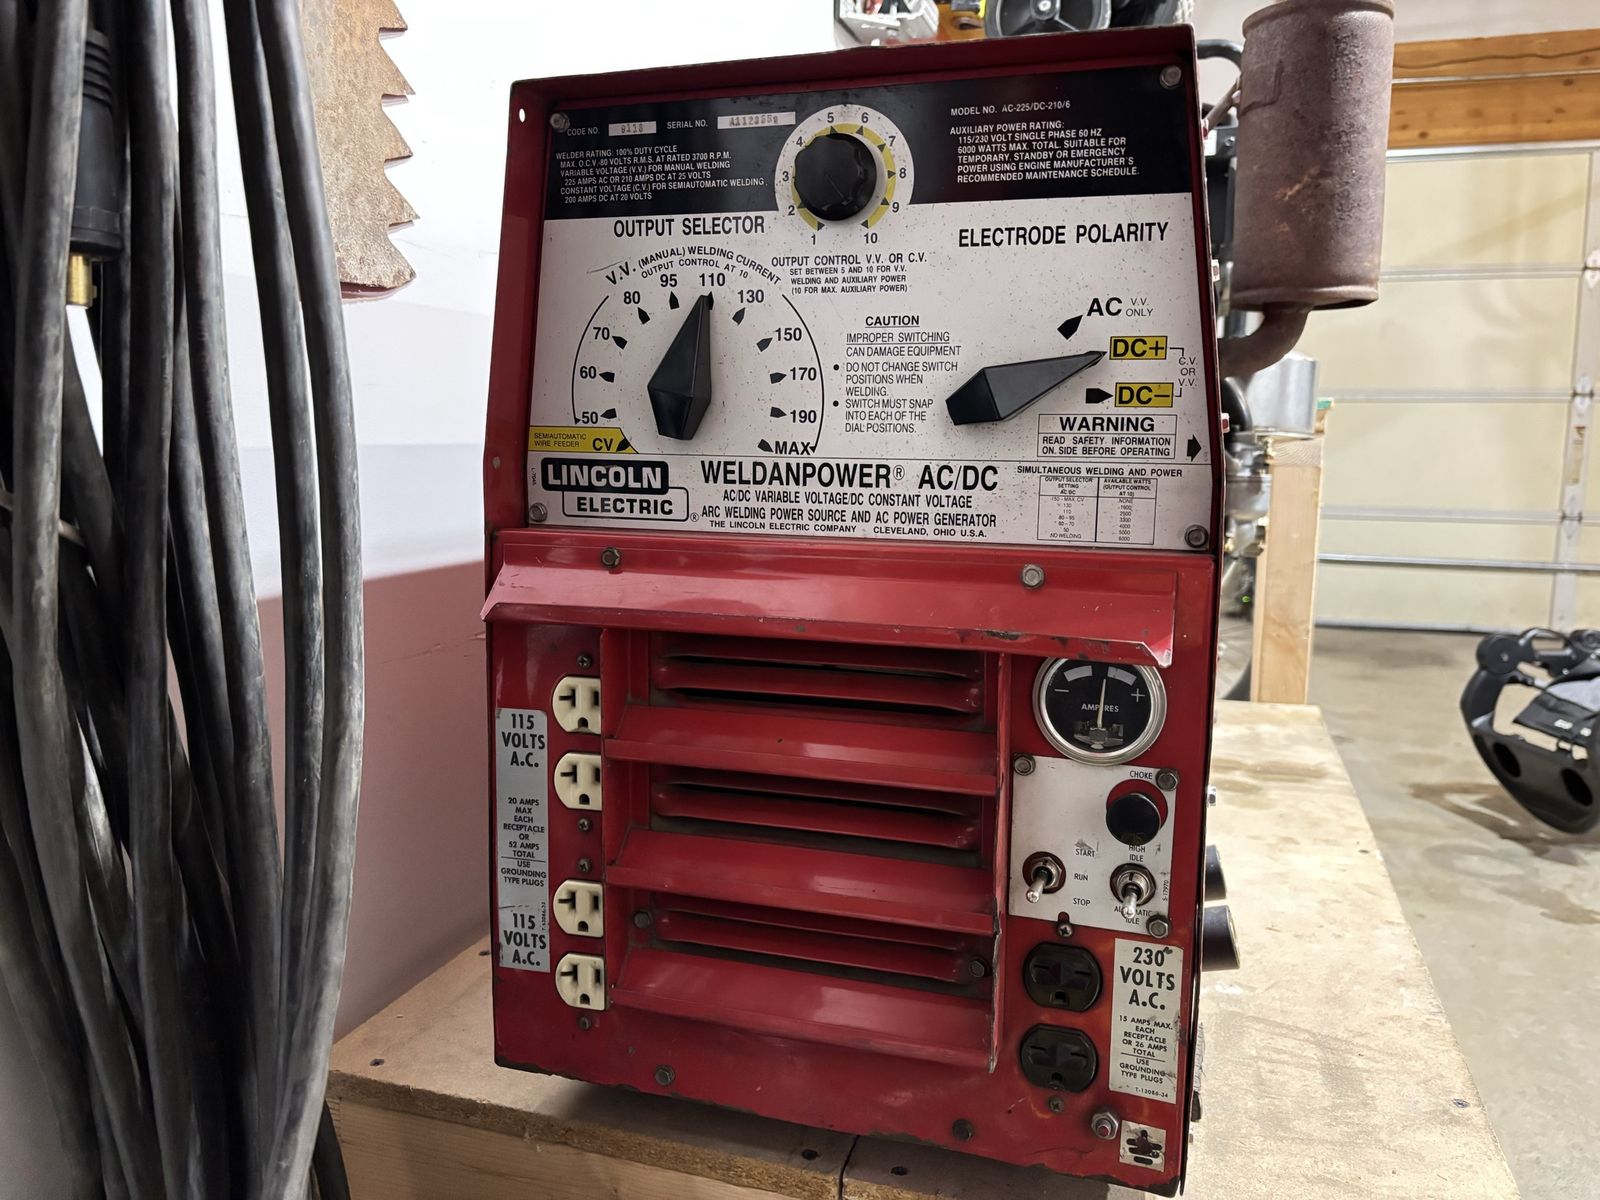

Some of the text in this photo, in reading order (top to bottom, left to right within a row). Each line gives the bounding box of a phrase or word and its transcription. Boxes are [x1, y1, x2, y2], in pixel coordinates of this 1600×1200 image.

[950, 100, 1070, 115] MODEL NO. AC-225/DC-210/6
[827, 113, 834, 123] 5
[861, 113, 869, 123] 6
[796, 136, 803, 147] 4
[888, 136, 896, 146] 7
[782, 171, 789, 182] 3
[899, 168, 906, 178] 8
[788, 205, 795, 216] 2
[892, 202, 900, 213] 9
[614, 215, 764, 237] OUTPUT SELECTOR
[811, 234, 816, 245] 1
[863, 233, 878, 244] 10
[959, 223, 1168, 248] ELECTRODE POLARITY
[771, 252, 927, 266] OUTPUT CONTROL V.V. OR C.V.
[605, 246, 781, 286] V.V. (MANUAL) WELDING CURRENT
[641, 258, 749, 279] OUTPUT CONTROL AT 10
[660, 273, 678, 288] 95
[699, 273, 726, 287] 110
[623, 290, 640, 304] 80
[737, 289, 764, 303] 130
[1086, 297, 1122, 317] AC
[1125, 308, 1153, 317] ONLY
[865, 315, 920, 326] CAUTION
[593, 327, 610, 340] 70
[776, 328, 802, 342] 150
[846, 331, 949, 344] IMPROPER SWITCHING
[846, 345, 961, 356] CAN DAMAGE EQUIPMENT
[1113, 339, 1164, 358] DC+
[846, 361, 957, 372] DO NOT CHANGE SWITCH
[1178, 357, 1198, 365] C.V.
[580, 366, 597, 379] 60
[790, 368, 817, 380] 170
[1181, 368, 1195, 376] OR
[846, 374, 922, 384] POSITIONS WHEN
[845, 386, 889, 397] WELDING.
[844, 398, 933, 409] SWITCH MUST SNAP
[582, 411, 598, 424] 50
[790, 410, 817, 423] 190
[846, 410, 926, 421] INTO EACH OF THE
[845, 422, 916, 433] DIAL POSITIONS.
[1059, 417, 1155, 432] WARNING
[592, 437, 613, 451] CV
[1042, 436, 1170, 445] READ SAFETY INFORMATION
[775, 442, 810, 455] MAX
[1042, 445, 1169, 455] ON SIDE BEFORE OPERATING
[547, 463, 662, 489] LINCOLN
[1017, 465, 1182, 477] SIMULTANEOUS WELDING AND POWER
[917, 465, 999, 491] AC/DC
[722, 489, 972, 508] AC/DC VARIABLE VOLTAGE/DC CONSTANT VOLTAGE
[576, 496, 673, 515] ELECTRIC
[700, 505, 996, 527] ARC WELDING POWER SOURCE AND AC POWER GENERATOR
[729, 521, 766, 529] LINCOLN
[769, 522, 810, 531] ELECTRIC
[814, 524, 856, 532] COMPANY
[873, 524, 986, 537] CLEVELAND, OHIO U.S.A.
[1081, 703, 1119, 713] AMPRES
[511, 713, 534, 730] 115
[502, 731, 545, 750] VOLTS
[510, 751, 539, 768] A.C.
[1129, 770, 1152, 779] CHOKE
[519, 798, 539, 806] AMPS
[514, 815, 533, 823] EACH
[503, 823, 544, 833] RECEPTACLE
[520, 842, 539, 850] AMPS
[512, 850, 535, 858] TOTAL
[1075, 849, 1095, 857] START
[1129, 854, 1143, 862] IDLE
[517, 860, 531, 868] USE
[501, 867, 546, 879] GROUNDING
[1074, 873, 1088, 881] RUN
[504, 876, 544, 887] TYPE PLUGS
[1073, 898, 1091, 906] STOP
[513, 913, 535, 930] 115
[504, 930, 546, 950] VOLTS
[512, 949, 540, 966] A.C.
[1133, 947, 1165, 967] 230
[1119, 966, 1175, 991] VOLTS
[1129, 990, 1166, 1010] A.C.
[1131, 1017, 1150, 1026] AMPS
[1153, 1020, 1173, 1030] MAX.
[1135, 1026, 1155, 1035] EACH
[1123, 1031, 1166, 1044] RECEPTACLE
[1133, 1048, 1156, 1058] TOTAL
[1147, 1042, 1166, 1052] AMPS
[1136, 1058, 1149, 1066] USE
[1119, 1063, 1166, 1077] GROUNDING
[1121, 1069, 1162, 1083] TYPE PLUGS
